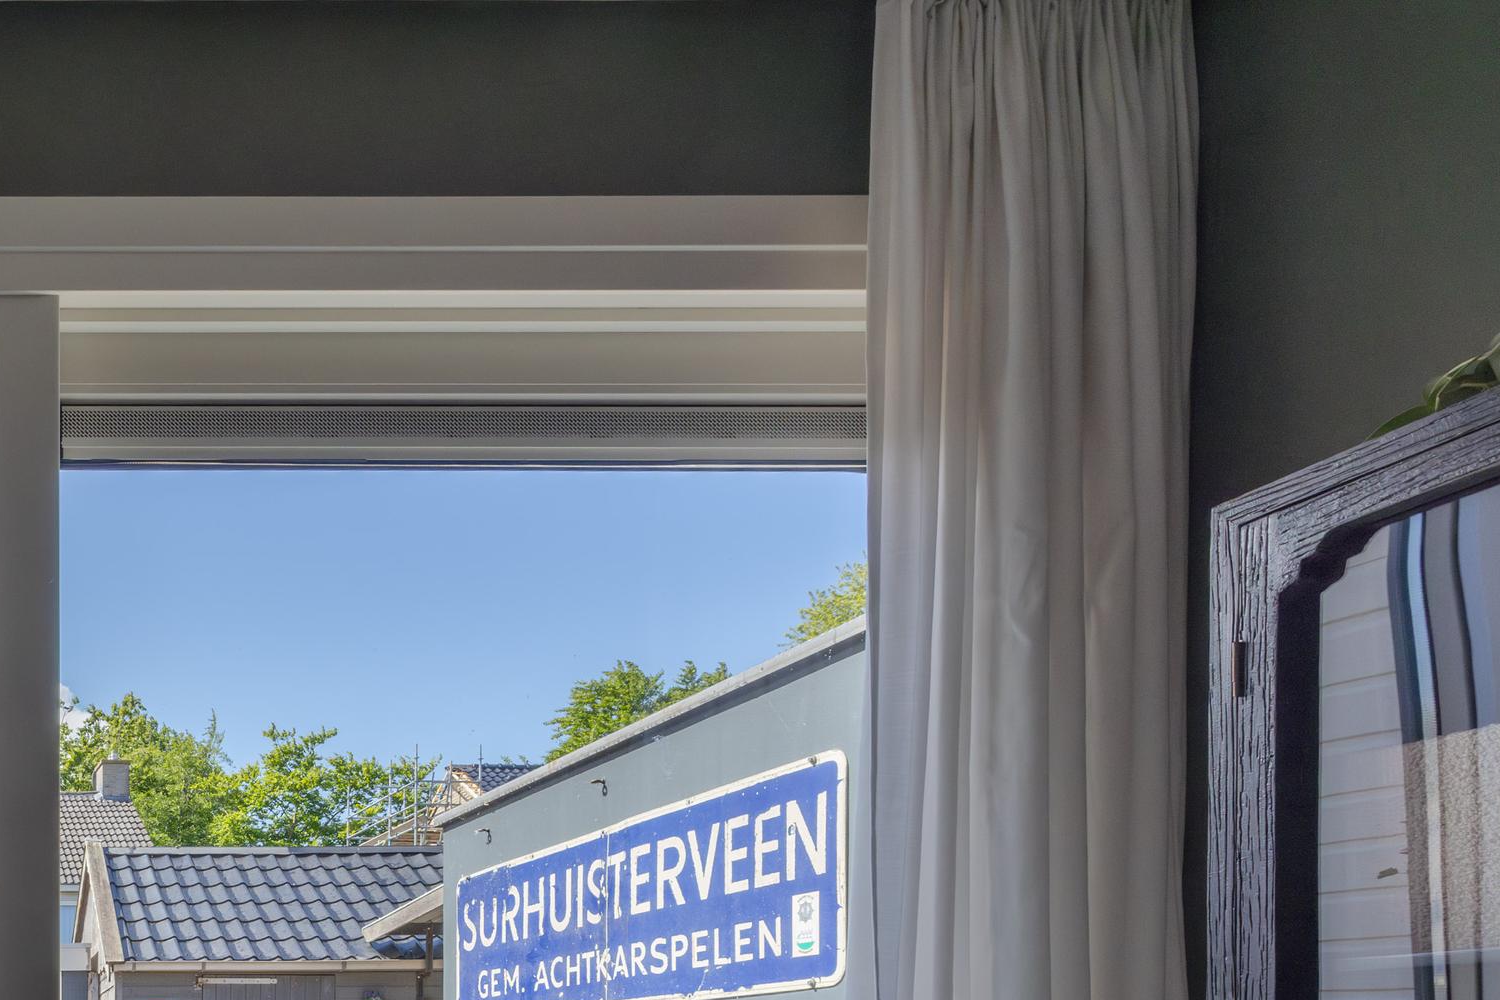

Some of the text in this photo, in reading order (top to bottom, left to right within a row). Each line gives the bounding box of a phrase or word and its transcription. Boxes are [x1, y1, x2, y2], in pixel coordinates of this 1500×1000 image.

[463, 790, 827, 952] SURHUISTERVEEN
[477, 916, 782, 999] GEM. ACHTKARSPELEN
